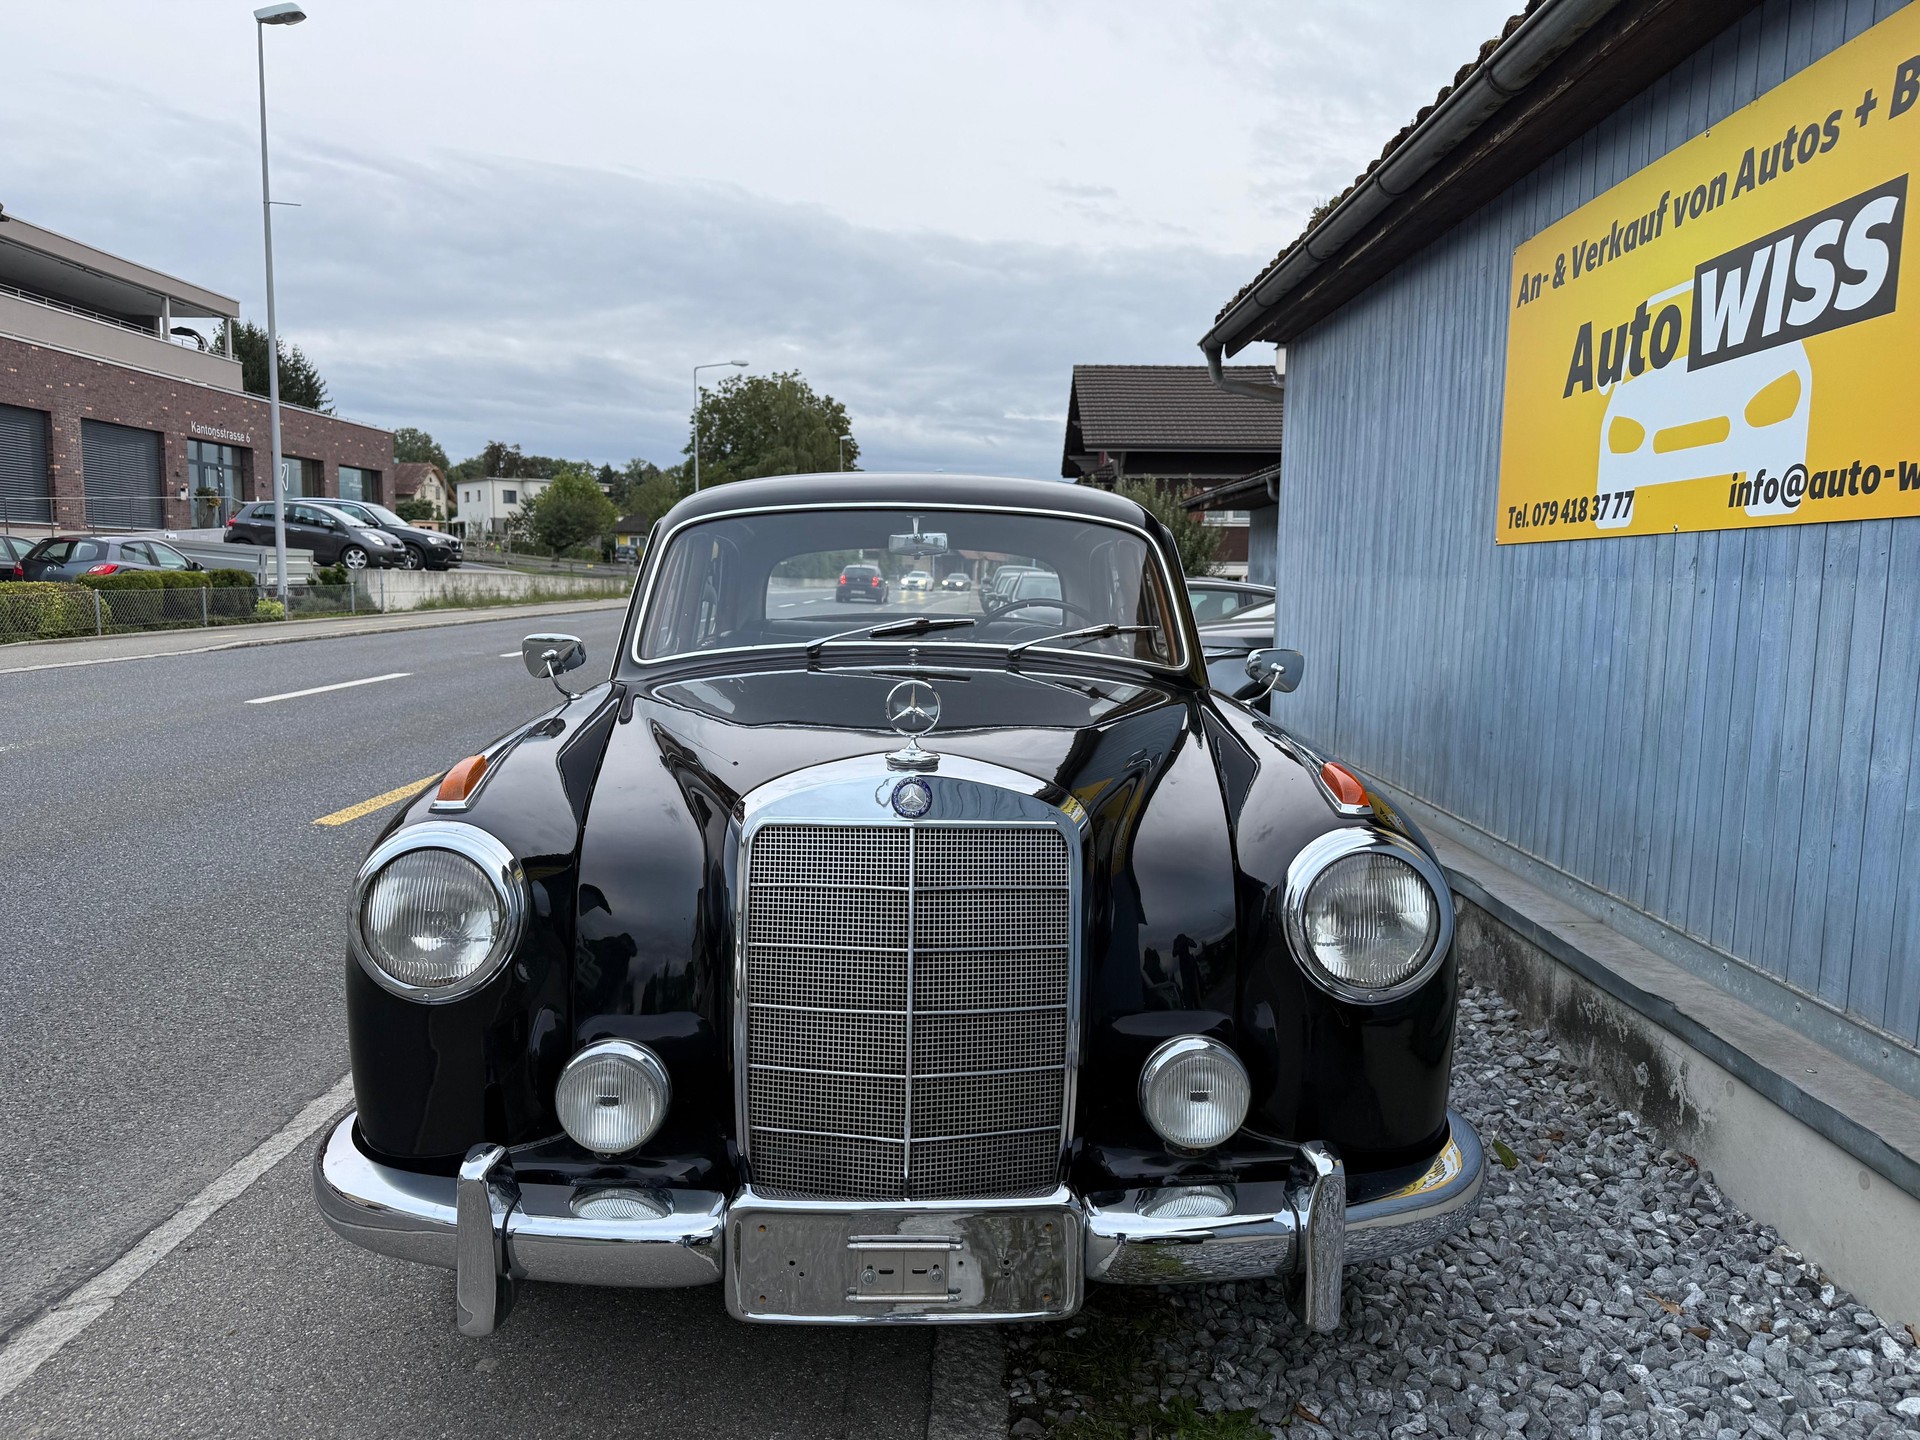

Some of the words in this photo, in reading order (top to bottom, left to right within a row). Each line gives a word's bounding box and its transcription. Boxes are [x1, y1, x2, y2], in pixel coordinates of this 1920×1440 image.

[1517, 273, 1549, 308] An-
[1552, 253, 1567, 289] &
[1572, 190, 1670, 279] Verkauf
[1674, 172, 1728, 229] von
[1731, 109, 1843, 200] Autos
[1854, 88, 1878, 128] +
[1563, 300, 1683, 399] Auto
[1701, 195, 1900, 356] WISS
[191, 421, 245, 441] Kantonsstrasse
[246, 432, 251, 443] 6
[1508, 503, 1529, 529] Tel.
[1532, 500, 1559, 527] 079
[1560, 496, 1589, 523] 418
[1590, 493, 1611, 521] 37
[1612, 490, 1635, 519] 77
